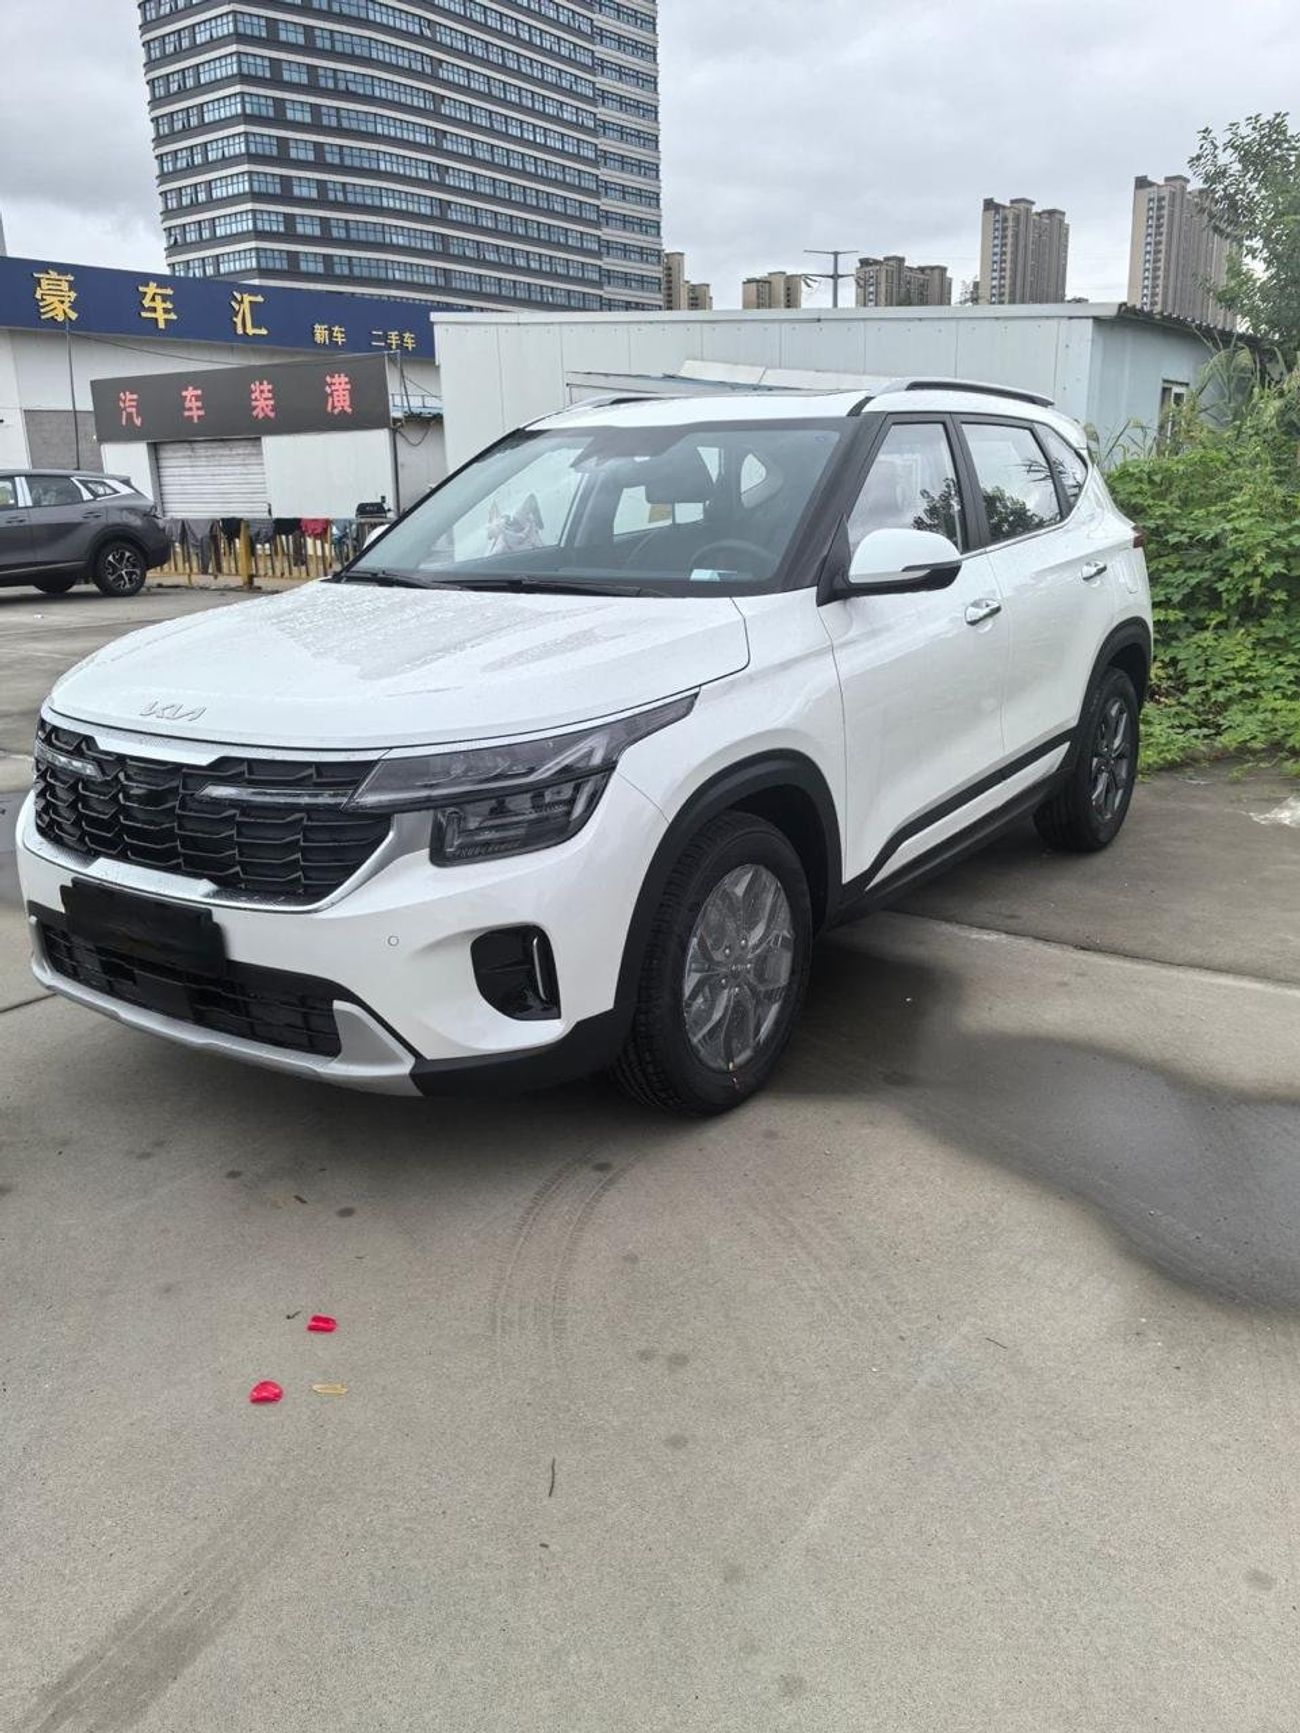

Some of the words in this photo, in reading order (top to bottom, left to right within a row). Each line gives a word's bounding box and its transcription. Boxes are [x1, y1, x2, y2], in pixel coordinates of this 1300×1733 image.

[33, 270, 269, 336] 豪车汇
[313, 323, 347, 345] 新车
[370, 330, 416, 351] 二手车
[119, 373, 353, 427] 汽车装潢
